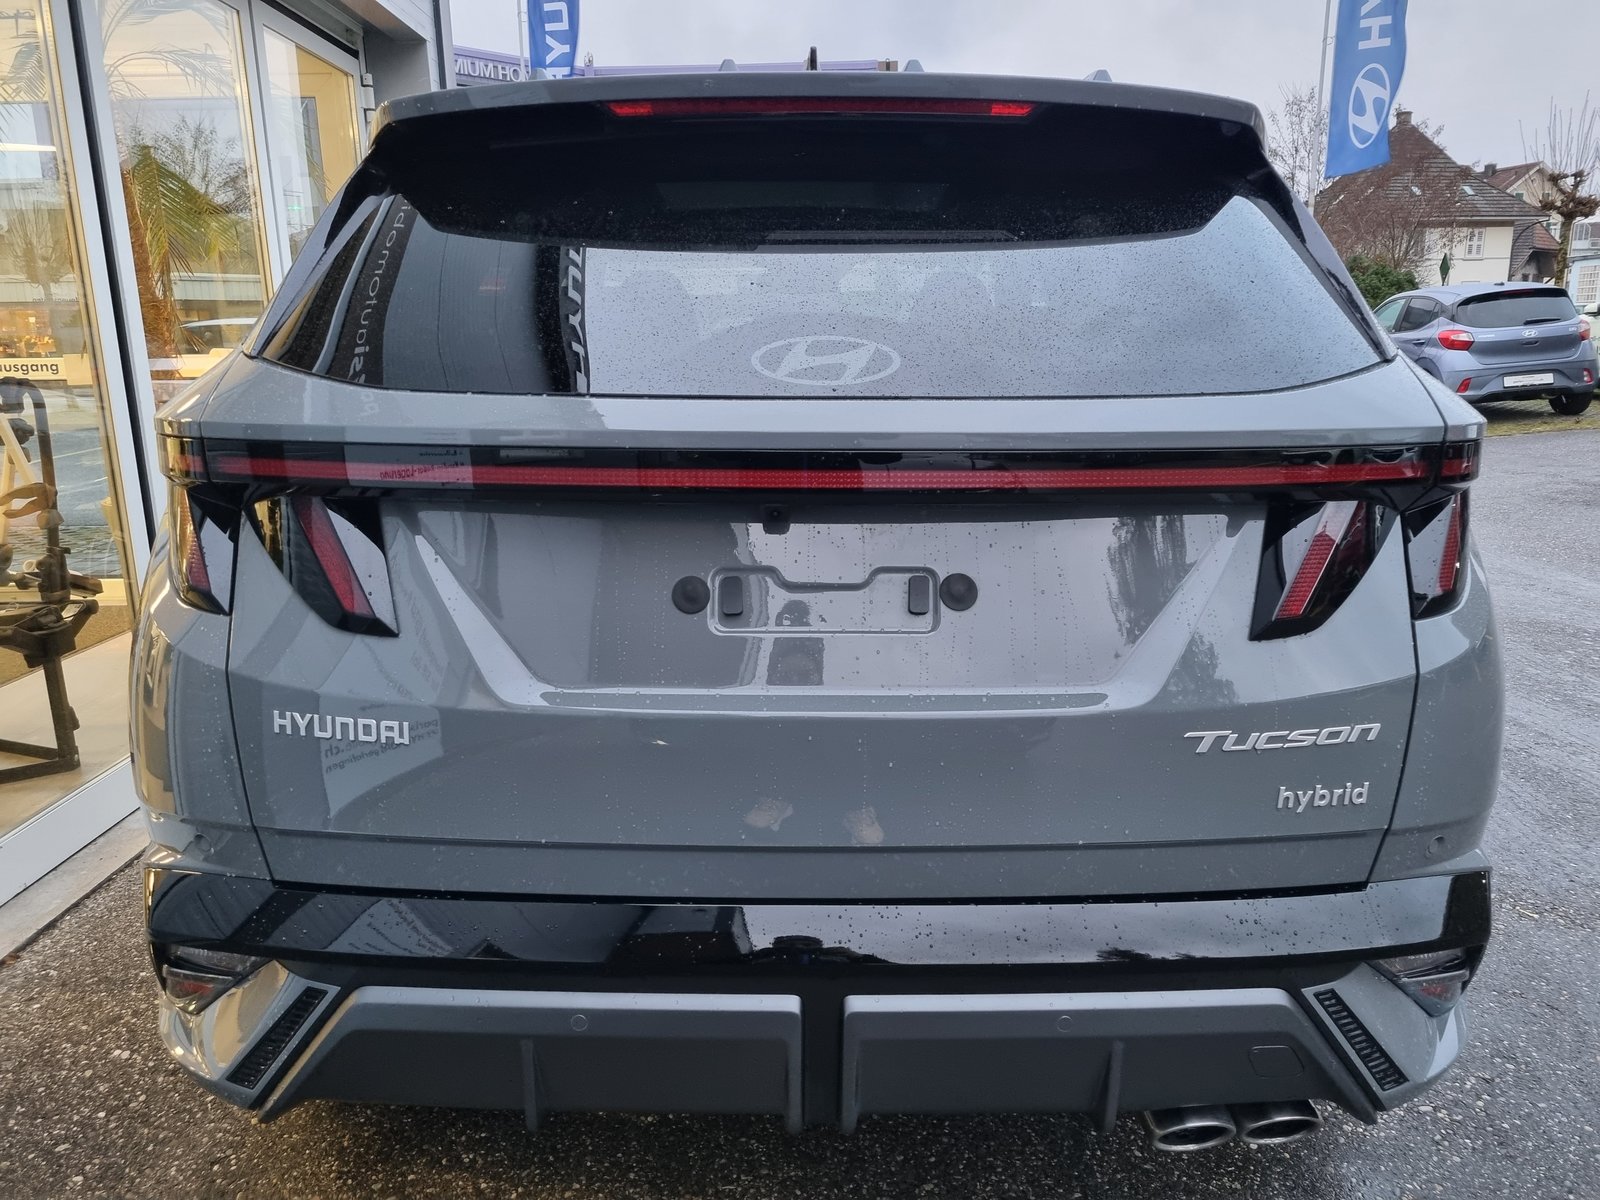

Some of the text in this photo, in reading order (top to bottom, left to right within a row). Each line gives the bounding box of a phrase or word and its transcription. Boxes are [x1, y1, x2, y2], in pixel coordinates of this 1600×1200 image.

[0, 363, 59, 375] usgang
[273, 710, 410, 745] HYUNDAI
[1277, 782, 1369, 813] hybrid
